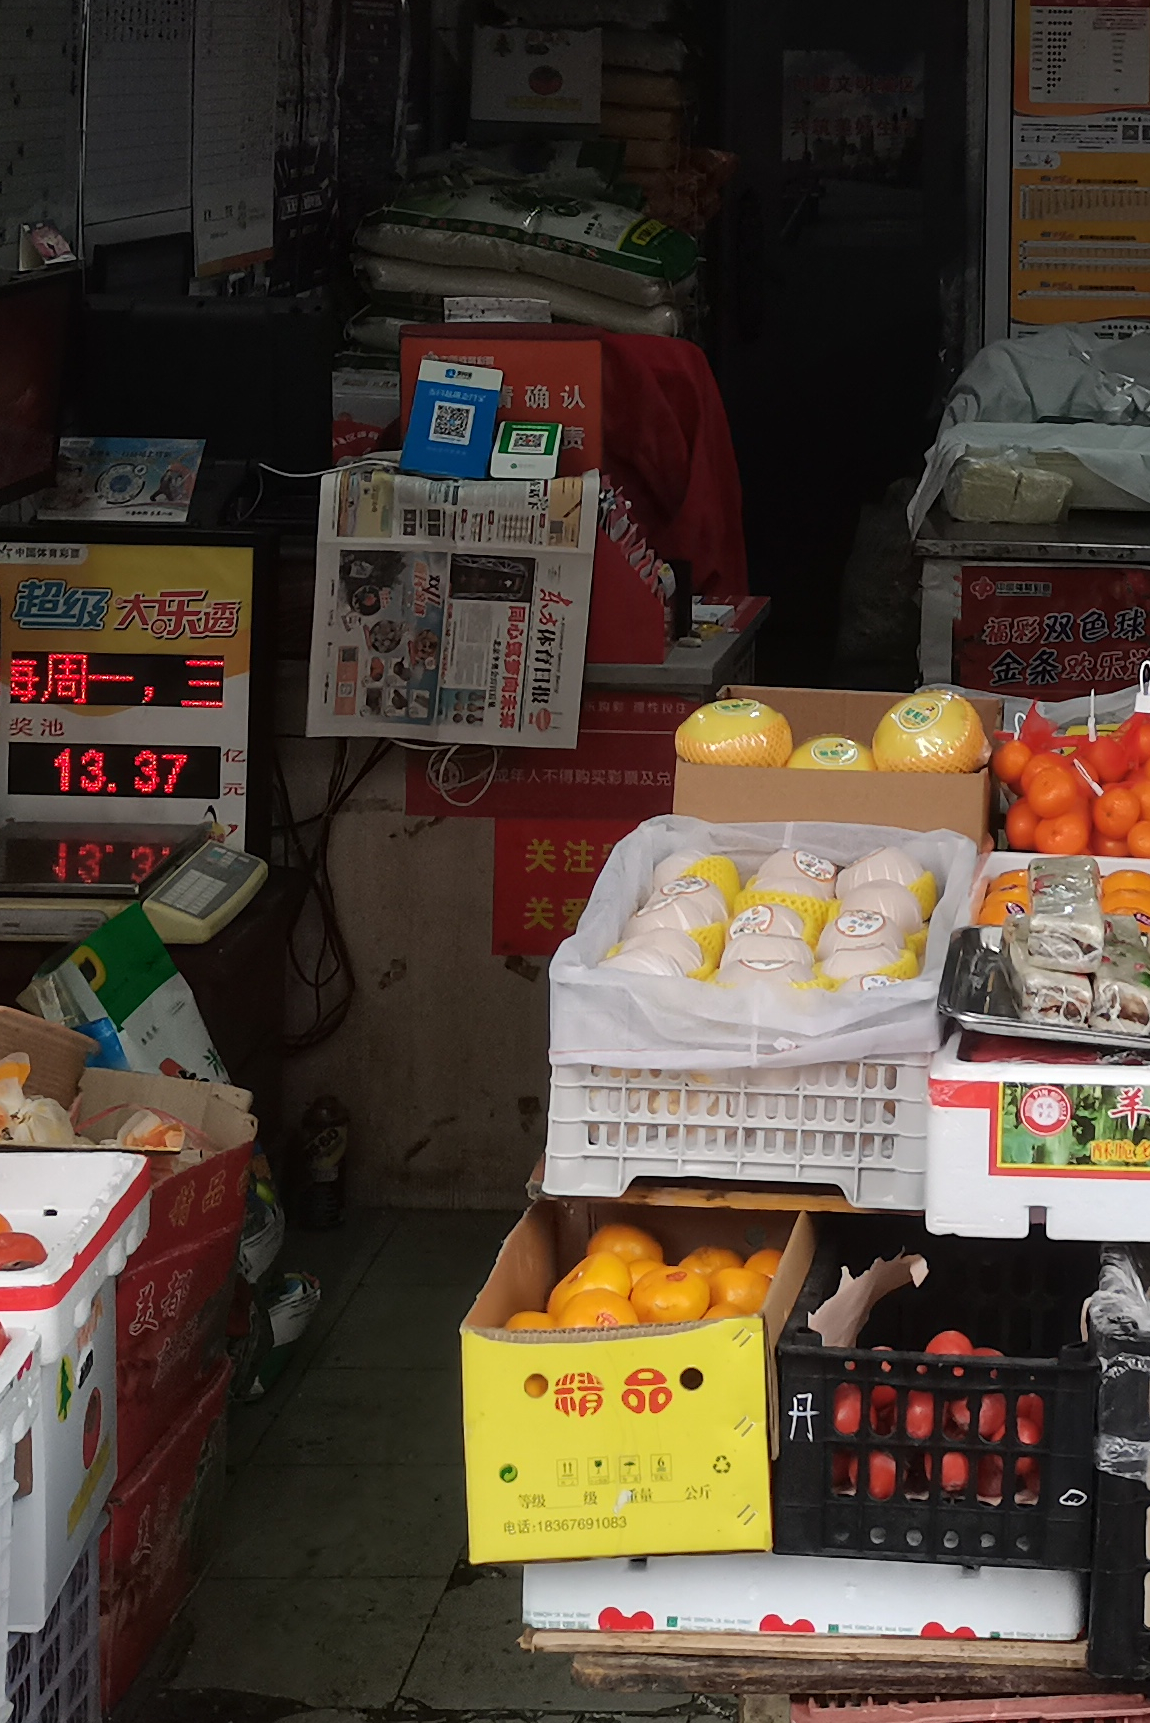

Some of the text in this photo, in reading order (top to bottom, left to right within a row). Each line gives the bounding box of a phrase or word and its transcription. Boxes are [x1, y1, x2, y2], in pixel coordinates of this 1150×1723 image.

[11, 578, 241, 639] 超级大乐透
[982, 607, 1146, 645] 福彩双色球
[9, 717, 65, 737] 奖池
[53, 748, 188, 793] 13.37
[553, 1368, 672, 1417] 精品
[518, 1493, 546, 1508] 等级
[584, 1491, 597, 1505] 级
[686, 1485, 712, 1499] 公斤
[503, 1516, 627, 1535] 电话:18367691083
